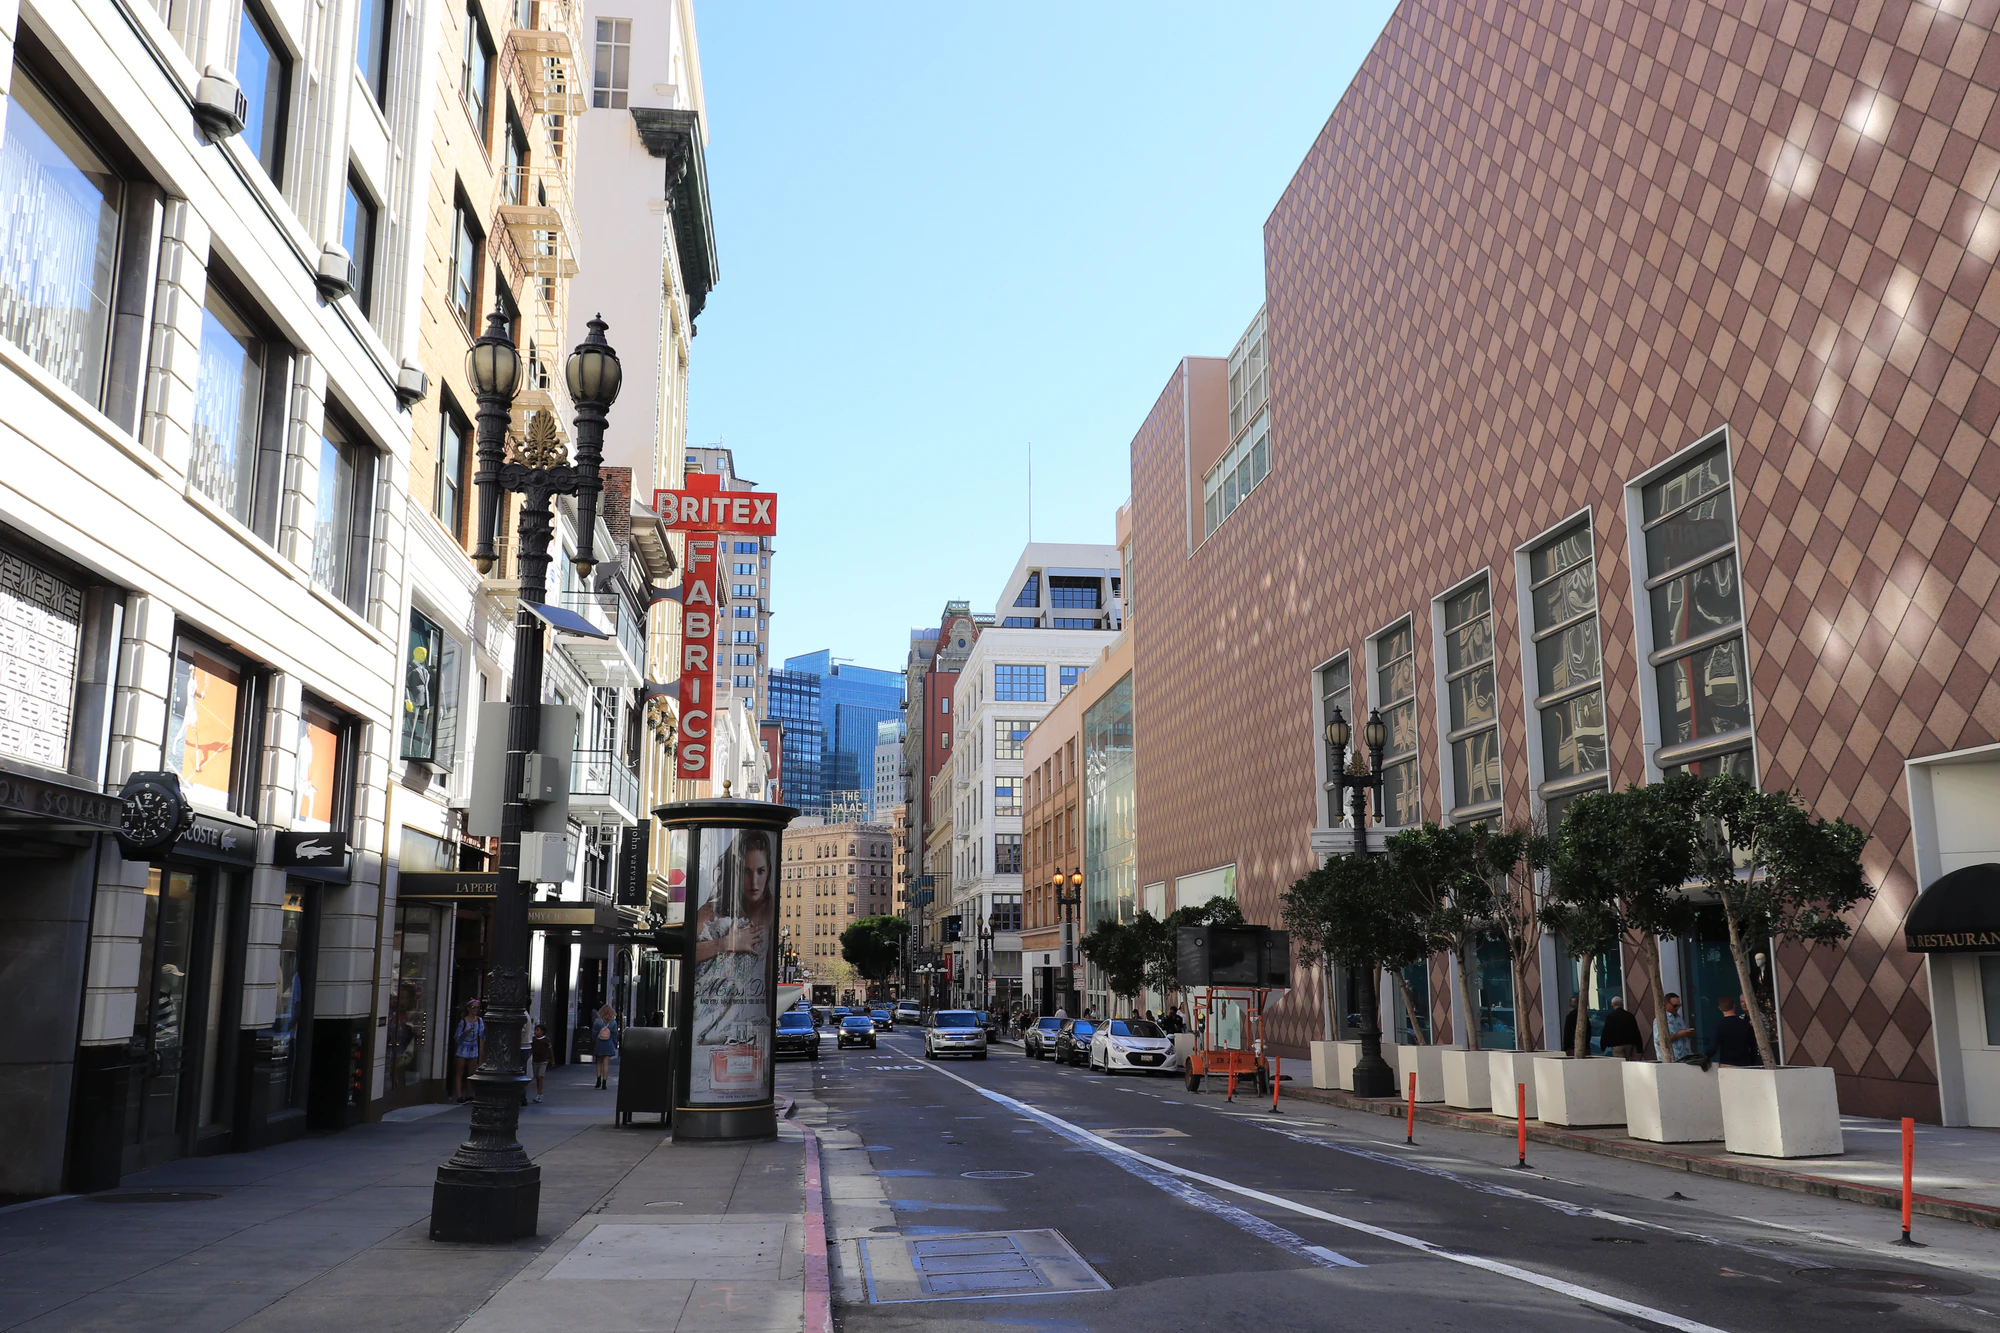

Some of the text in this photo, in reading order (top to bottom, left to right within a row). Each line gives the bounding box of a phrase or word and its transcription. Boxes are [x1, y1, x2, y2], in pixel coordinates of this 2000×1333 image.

[657, 492, 772, 527] BRITEX
[681, 539, 714, 772] FABRICS
[43, 790, 119, 822] SQUARE
[842, 791, 860, 801] THE
[832, 802, 868, 813] PALACE
[183, 824, 219, 846] COSTE
[629, 828, 641, 897] john varvatos
[455, 882, 498, 893] LA PERL
[528, 912, 546, 921] MMY
[1917, 932, 2000, 948] RESTAURAN
[697, 977, 745, 997] Miss
